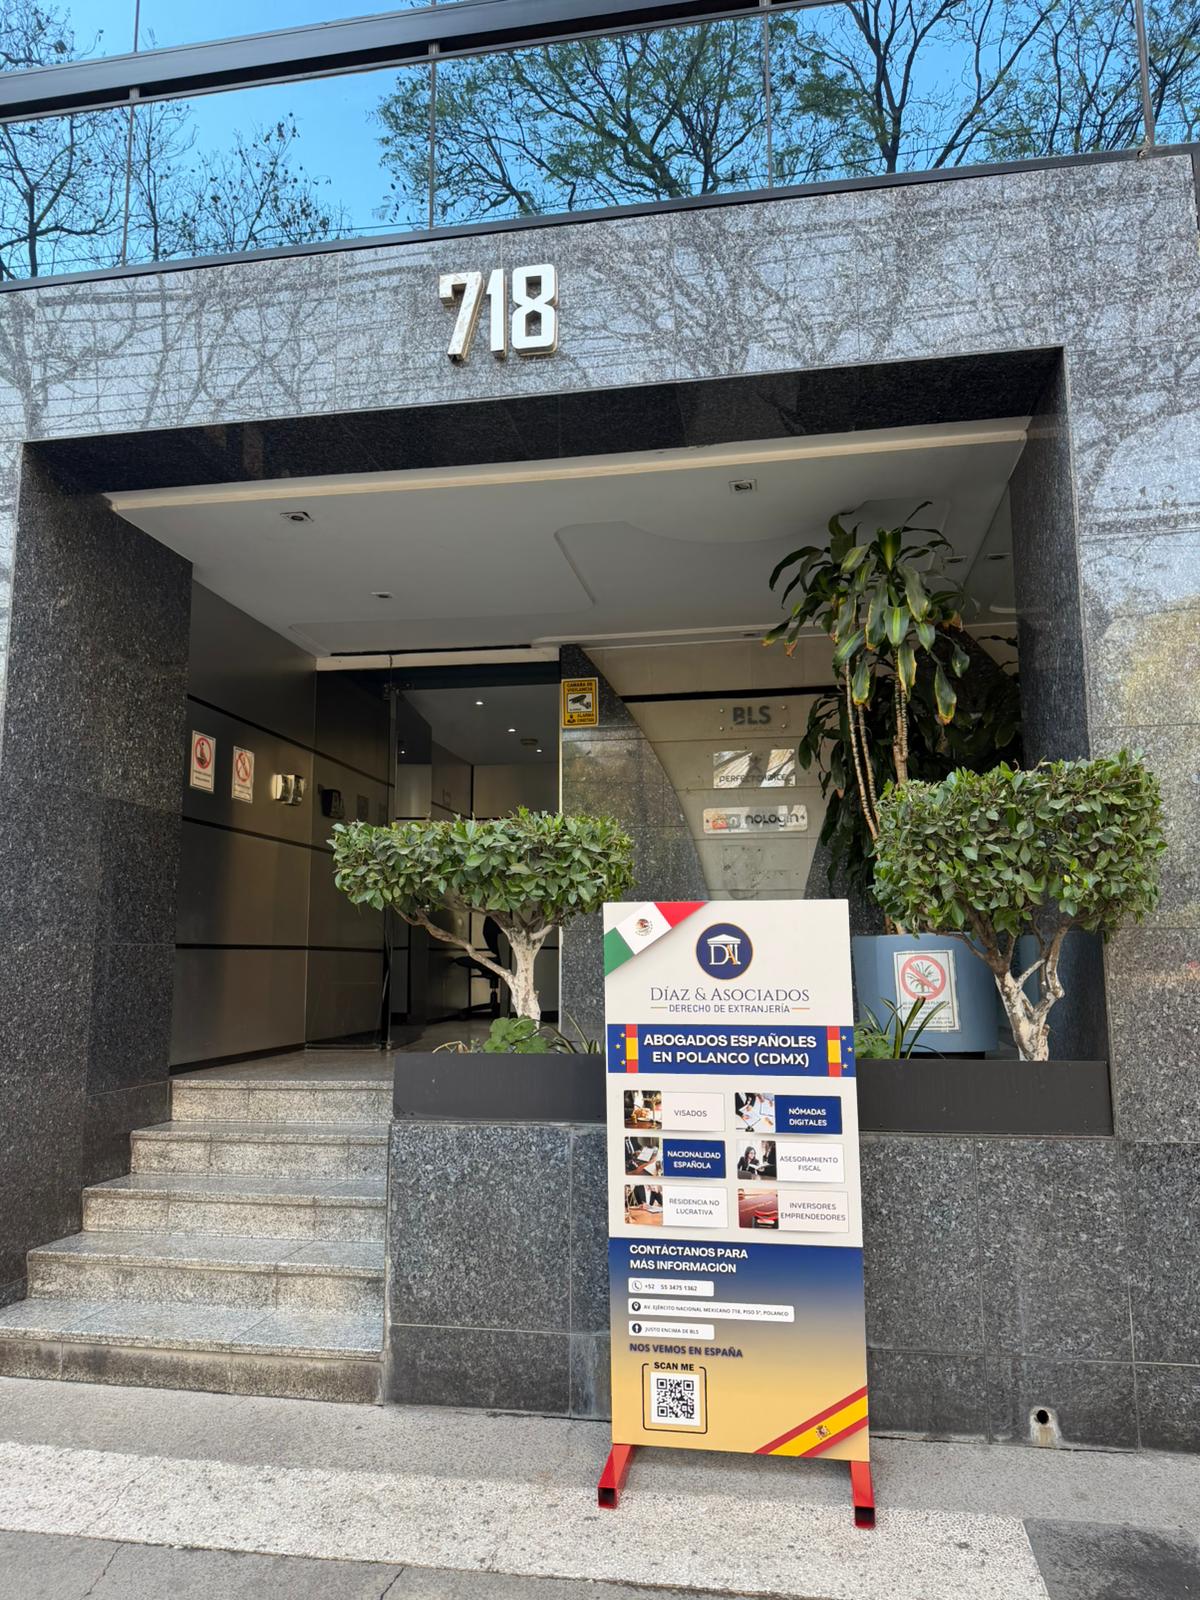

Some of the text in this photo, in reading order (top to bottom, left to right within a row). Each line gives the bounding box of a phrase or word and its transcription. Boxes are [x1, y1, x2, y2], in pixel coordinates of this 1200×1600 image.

[440, 264, 558, 360] 718
[733, 706, 771, 725] BLS
[650, 986, 810, 1002] DÍAZ & ASOCIADOS
[668, 1002, 790, 1013] DERECHO DE EXTRANJERÍA
[643, 1033, 817, 1048] ABOGADOS ESPAÑOLES
[652, 1051, 810, 1068] EN POLANCO (CDMX)
[673, 1109, 708, 1118] VISADOS
[788, 1106, 827, 1116] NÓMADAS
[789, 1118, 827, 1127] DIGITALES
[667, 1150, 721, 1159] NACIONALIDAD
[673, 1160, 712, 1170] ESPAÑOLA
[779, 1156, 838, 1164] ASESORAMIENTO
[798, 1164, 822, 1172] FISCAL
[669, 1197, 720, 1207] RESIDENCIA NO
[789, 1202, 837, 1211] INVERSORES
[676, 1207, 713, 1216] LUCRATIVA
[780, 1212, 846, 1222] EMPRENDEDORES
[629, 1244, 749, 1259] CONTÁCTANOS PARA
[630, 1258, 737, 1273] MÁS INFORMACIÓN
[629, 1342, 743, 1358] NOS VEMOS EN ESPAÑA
[654, 1361, 695, 1371] SCAN ME
